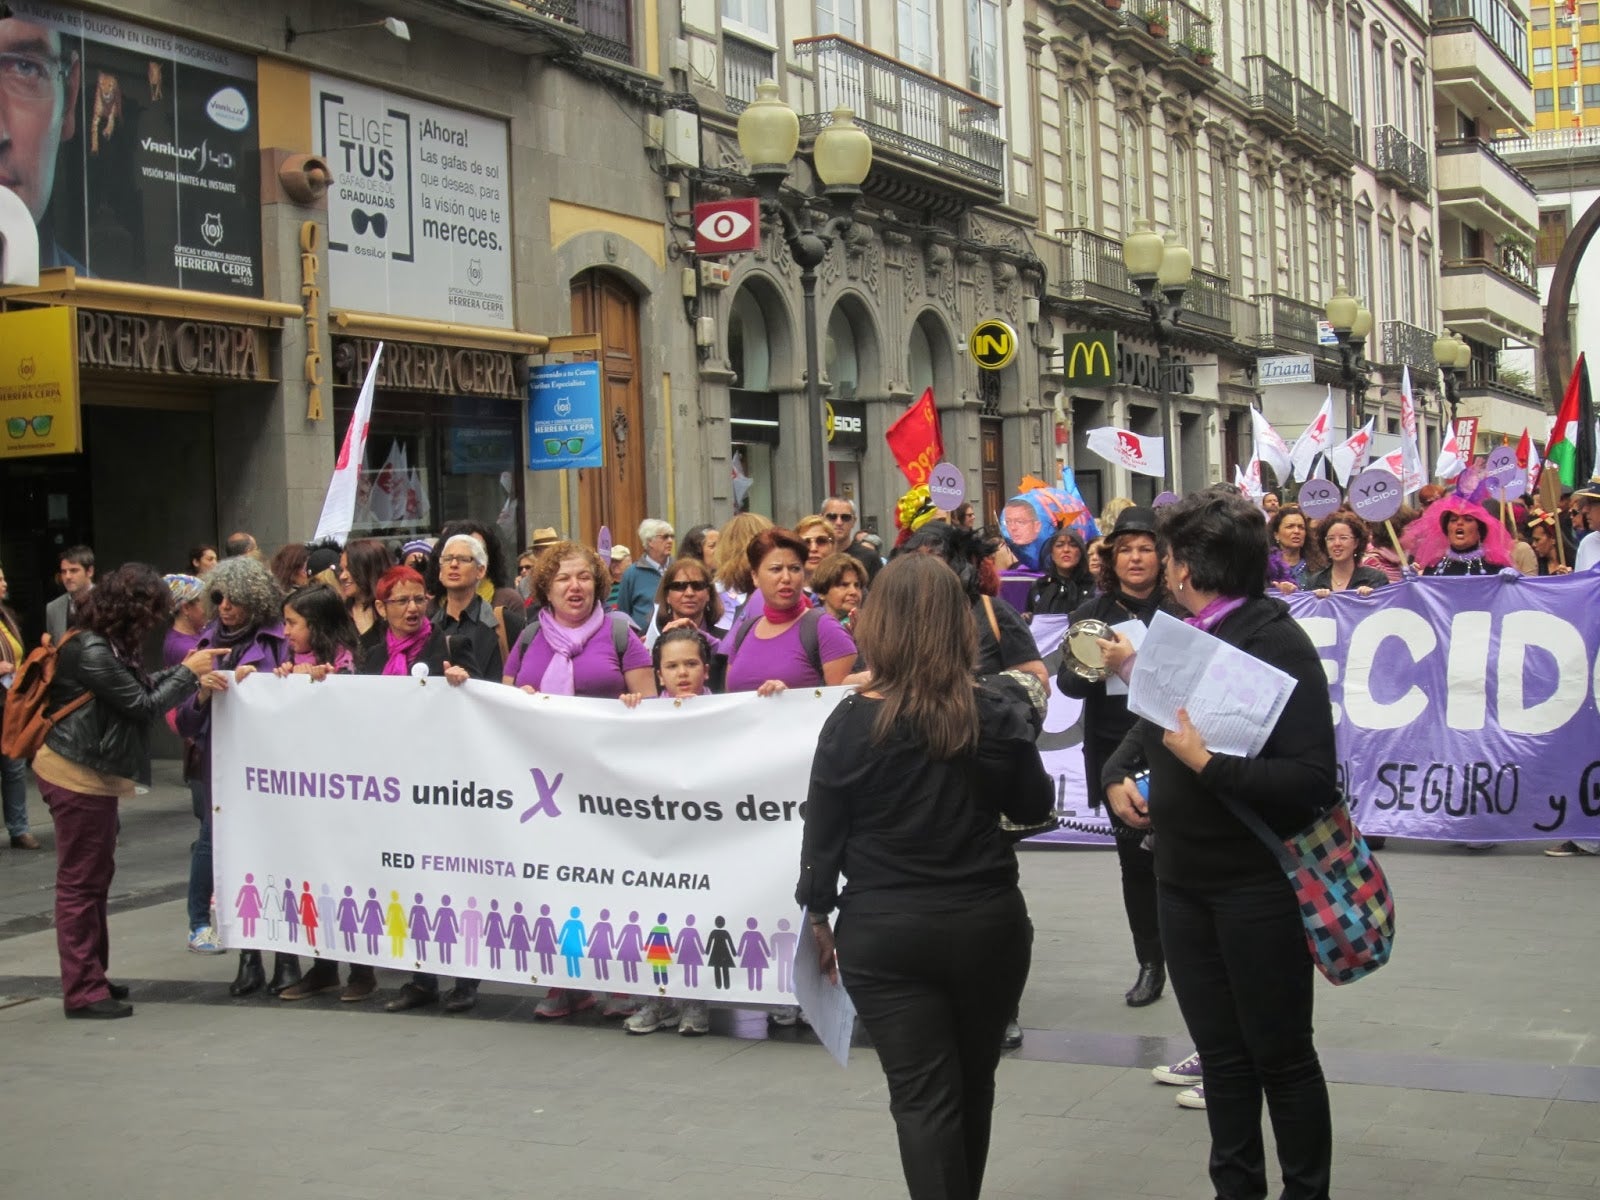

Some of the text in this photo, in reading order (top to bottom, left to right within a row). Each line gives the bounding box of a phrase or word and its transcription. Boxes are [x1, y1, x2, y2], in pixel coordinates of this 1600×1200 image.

[128, 31, 140, 43] EN
[142, 35, 172, 51] LENTES
[338, 111, 394, 148] ELIGE
[419, 118, 469, 148] ¡Ahora!
[339, 140, 394, 182] TUS
[420, 147, 499, 179] Las gafas de sol
[142, 166, 164, 180] VISIÓN
[164, 171, 176, 182] SIN
[200, 178, 208, 188] AL
[208, 180, 237, 194] INSTANTE
[339, 173, 395, 196] GAFAS DE SOL
[420, 173, 500, 201] que deseas, para
[340, 188, 396, 209] GRADUADAS
[421, 192, 500, 223] la visión que te
[423, 218, 502, 251] mereces.
[174, 255, 253, 278] HERRERA CERPA
[448, 295, 504, 313] HERRERA CERPA
[175, 322, 261, 377] CERPA
[354, 338, 518, 396] HERRERA CERPA
[1262, 361, 1310, 377] Triana
[534, 423, 595, 433] HERRERA CERPA
[1492, 456, 1510, 468] YO
[931, 485, 962, 496] DECIDO
[936, 475, 956, 488] YO
[1359, 481, 1387, 497] YO
[1303, 497, 1338, 507] DECIDO
[1307, 489, 1330, 499] YO
[1356, 489, 1398, 509] DECIDO
[245, 766, 401, 804] FEMINISTAS
[412, 780, 514, 810] unidas
[519, 767, 564, 824] X
[578, 793, 724, 822] nuestros
[1374, 761, 1519, 817] SEGURO
[1533, 794, 1567, 832] y
[381, 851, 711, 891] RED FEMINISTA DE GRAN CANARIA
